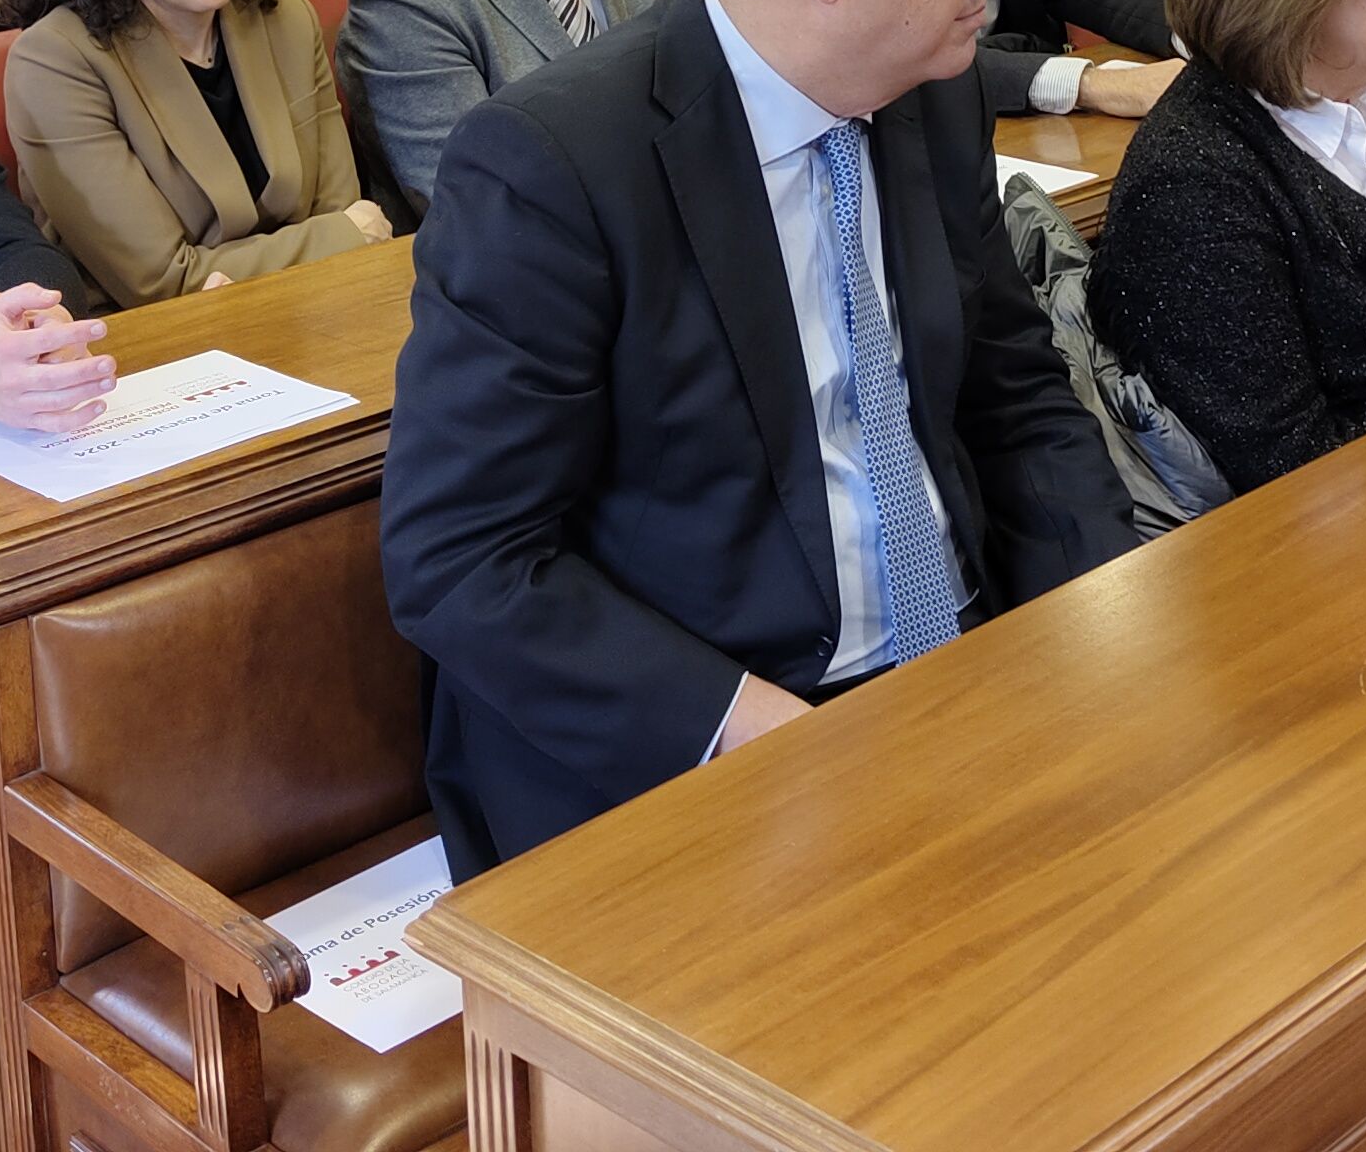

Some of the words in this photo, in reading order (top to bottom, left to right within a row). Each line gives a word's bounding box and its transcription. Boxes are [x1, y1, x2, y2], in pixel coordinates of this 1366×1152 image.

[235, 389, 285, 407] Toma
[210, 404, 233, 419] de
[131, 412, 209, 440] Posesión
[73, 440, 122, 458] 2024
[302, 939, 339, 961] oma
[340, 926, 365, 941] de
[363, 888, 442, 929] Posesión
[343, 969, 385, 992] COLEGIO
[385, 963, 396, 973] DE
[397, 957, 410, 967] LA
